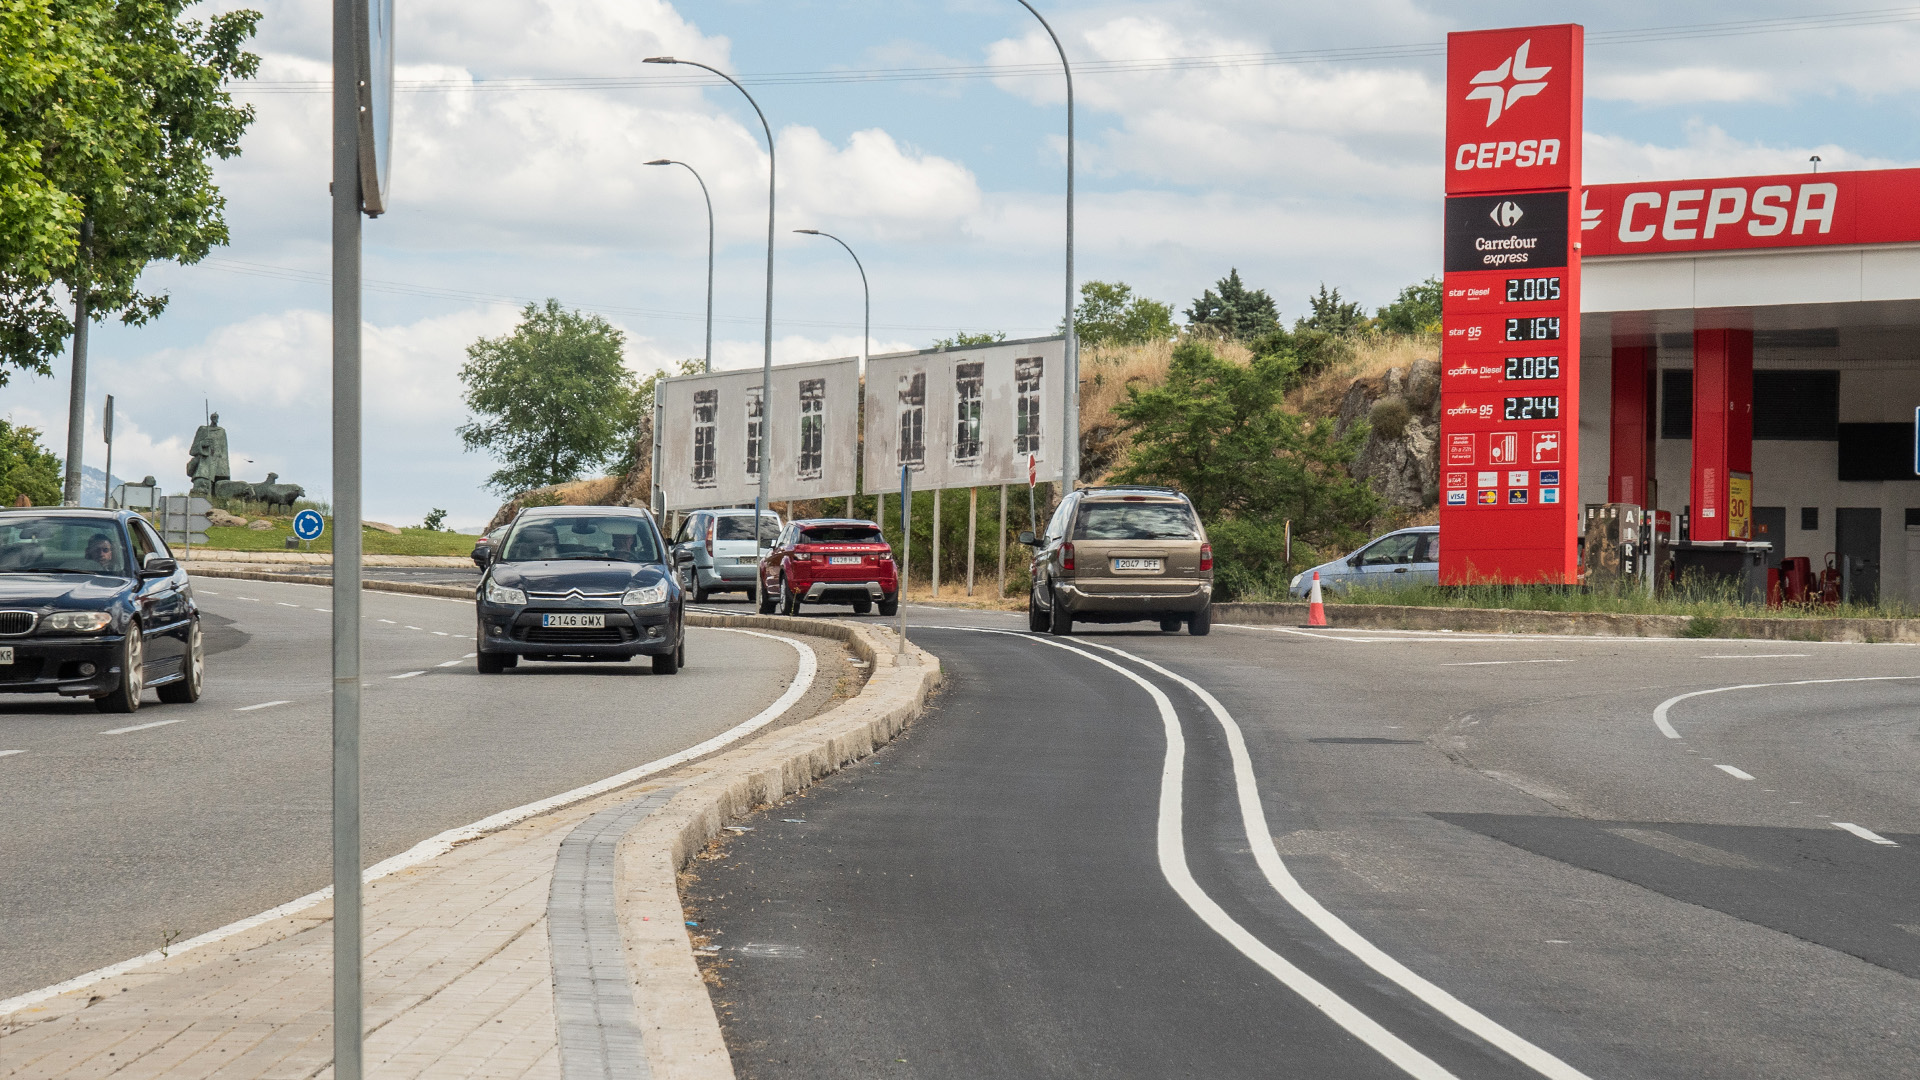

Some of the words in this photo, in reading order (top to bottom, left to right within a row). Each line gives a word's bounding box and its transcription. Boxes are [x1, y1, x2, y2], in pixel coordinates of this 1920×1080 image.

[1454, 138, 1561, 171] CEPSA
[1617, 182, 1838, 243] CEPSA
[1475, 236, 1537, 251] Carrefour
[1483, 252, 1529, 266] express
[1448, 289, 1466, 297] star
[1467, 287, 1490, 296] Diesel
[1507, 277, 1561, 301] 2.005
[1448, 328, 1466, 336] star
[1467, 326, 1482, 337] 95
[1506, 316, 1560, 341] 2.164
[1447, 366, 1478, 378] optima
[1479, 365, 1503, 375] Diesel
[1506, 356, 1560, 380] 2.085
[1447, 406, 1478, 417] optima
[1479, 404, 1493, 416] 95
[1505, 396, 1559, 420] 2.244
[1731, 498, 1744, 518] 30
[1120, 559, 1140, 568] 2047
[549, 615, 577, 626] 2146
[580, 615, 602, 626] GMX
[0, 650, 12, 661] KR
